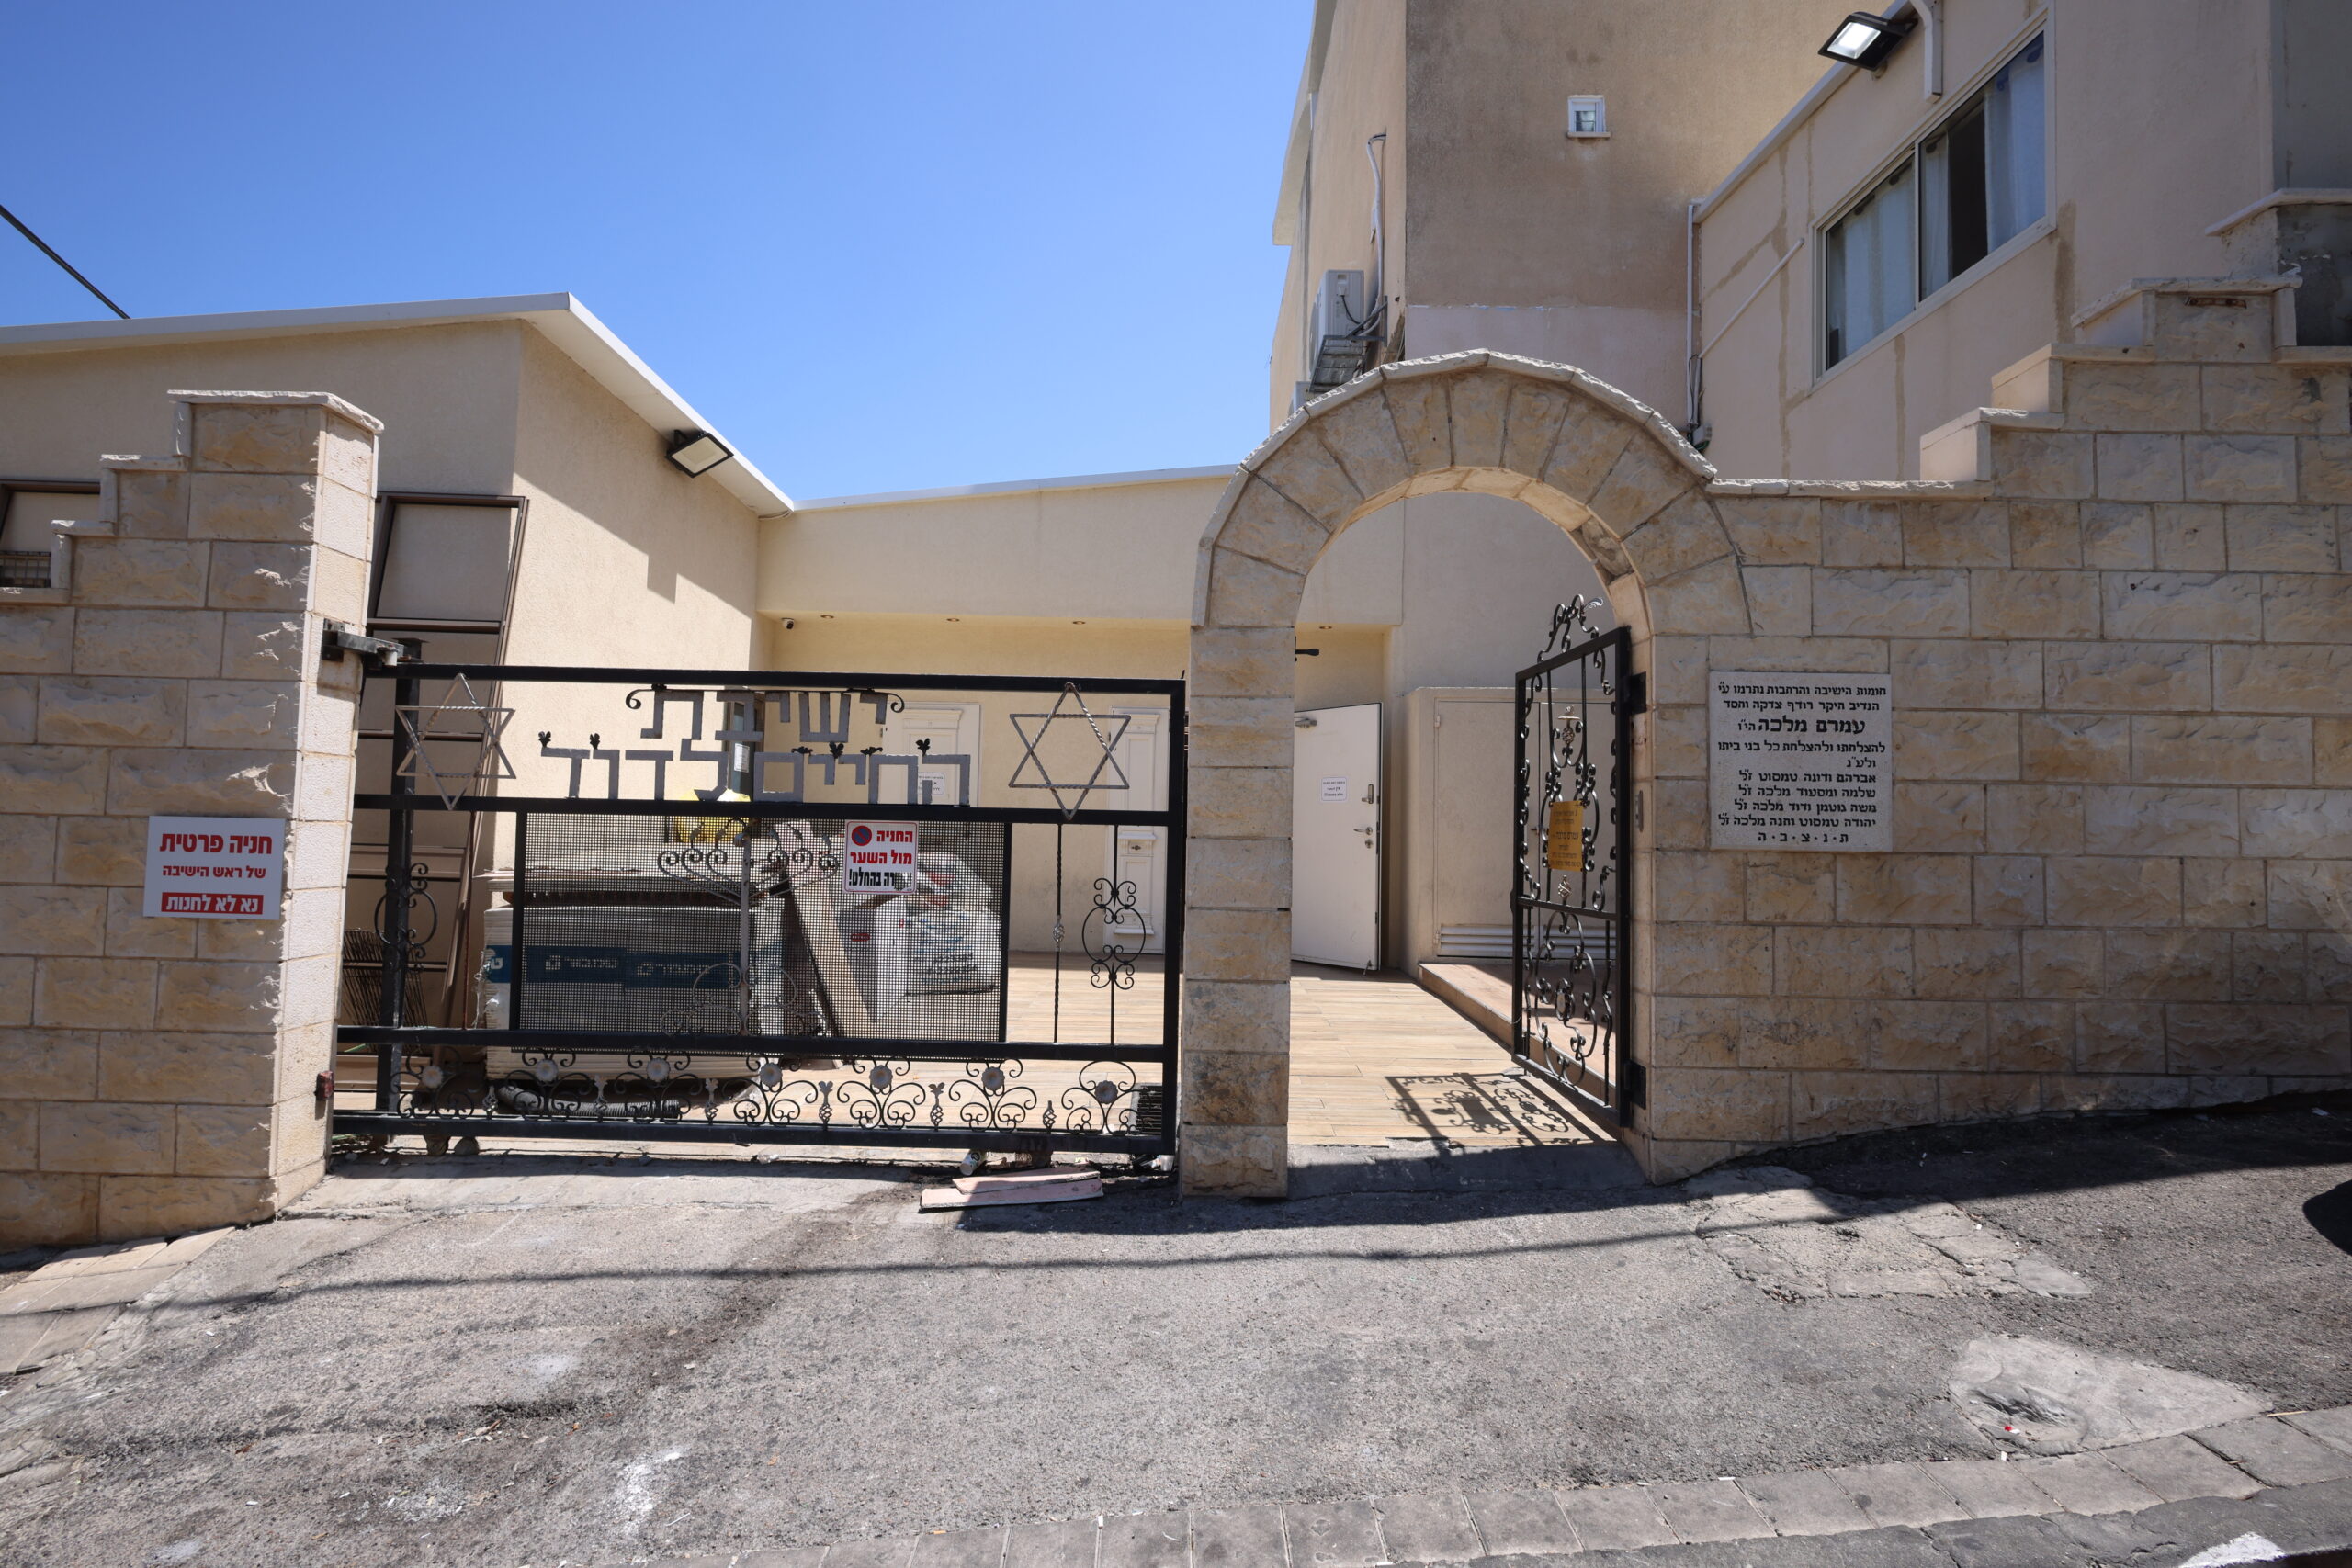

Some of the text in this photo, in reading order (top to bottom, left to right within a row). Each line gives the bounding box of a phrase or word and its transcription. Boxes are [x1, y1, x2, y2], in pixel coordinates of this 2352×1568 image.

[1733, 685, 1765, 694] נתרמו
[1766, 685, 1811, 695] והרחבות
[1814, 686, 1852, 695] הישיבה
[1855, 686, 1887, 696] חומות
[1723, 700, 1880, 714] הנדיב היקר רודף צדקה וחסד
[640, 692, 888, 744] ישיבת
[1758, 715, 1808, 732] מלכה
[1815, 719, 1866, 735] עמרם
[1717, 739, 1886, 753] להצלחתו ולהצלחת כל בני ביתו
[1758, 773, 1798, 783] טמסוט
[1836, 773, 1877, 784] אברהם
[1757, 784, 1792, 797] מלכה
[1795, 787, 1838, 797] ומסעוד
[1841, 785, 1876, 798] שלמה
[1752, 798, 1784, 812] מלכה
[1788, 802, 1812, 812] ודוד
[1850, 804, 1877, 813] משה
[1733, 813, 1766, 827] מלכה
[1769, 817, 1796, 827] וחנה
[1798, 818, 1839, 828] טמסוט
[1844, 818, 1876, 828] יהודה
[876, 829, 914, 843] החניה
[159, 833, 273, 855] חניה פרטית
[849, 849, 913, 865] מול השער
[162, 865, 266, 879] של ראש הישיבה
[848, 866, 882, 886] בהחלט!
[165, 894, 259, 913] נא לא לחנות
